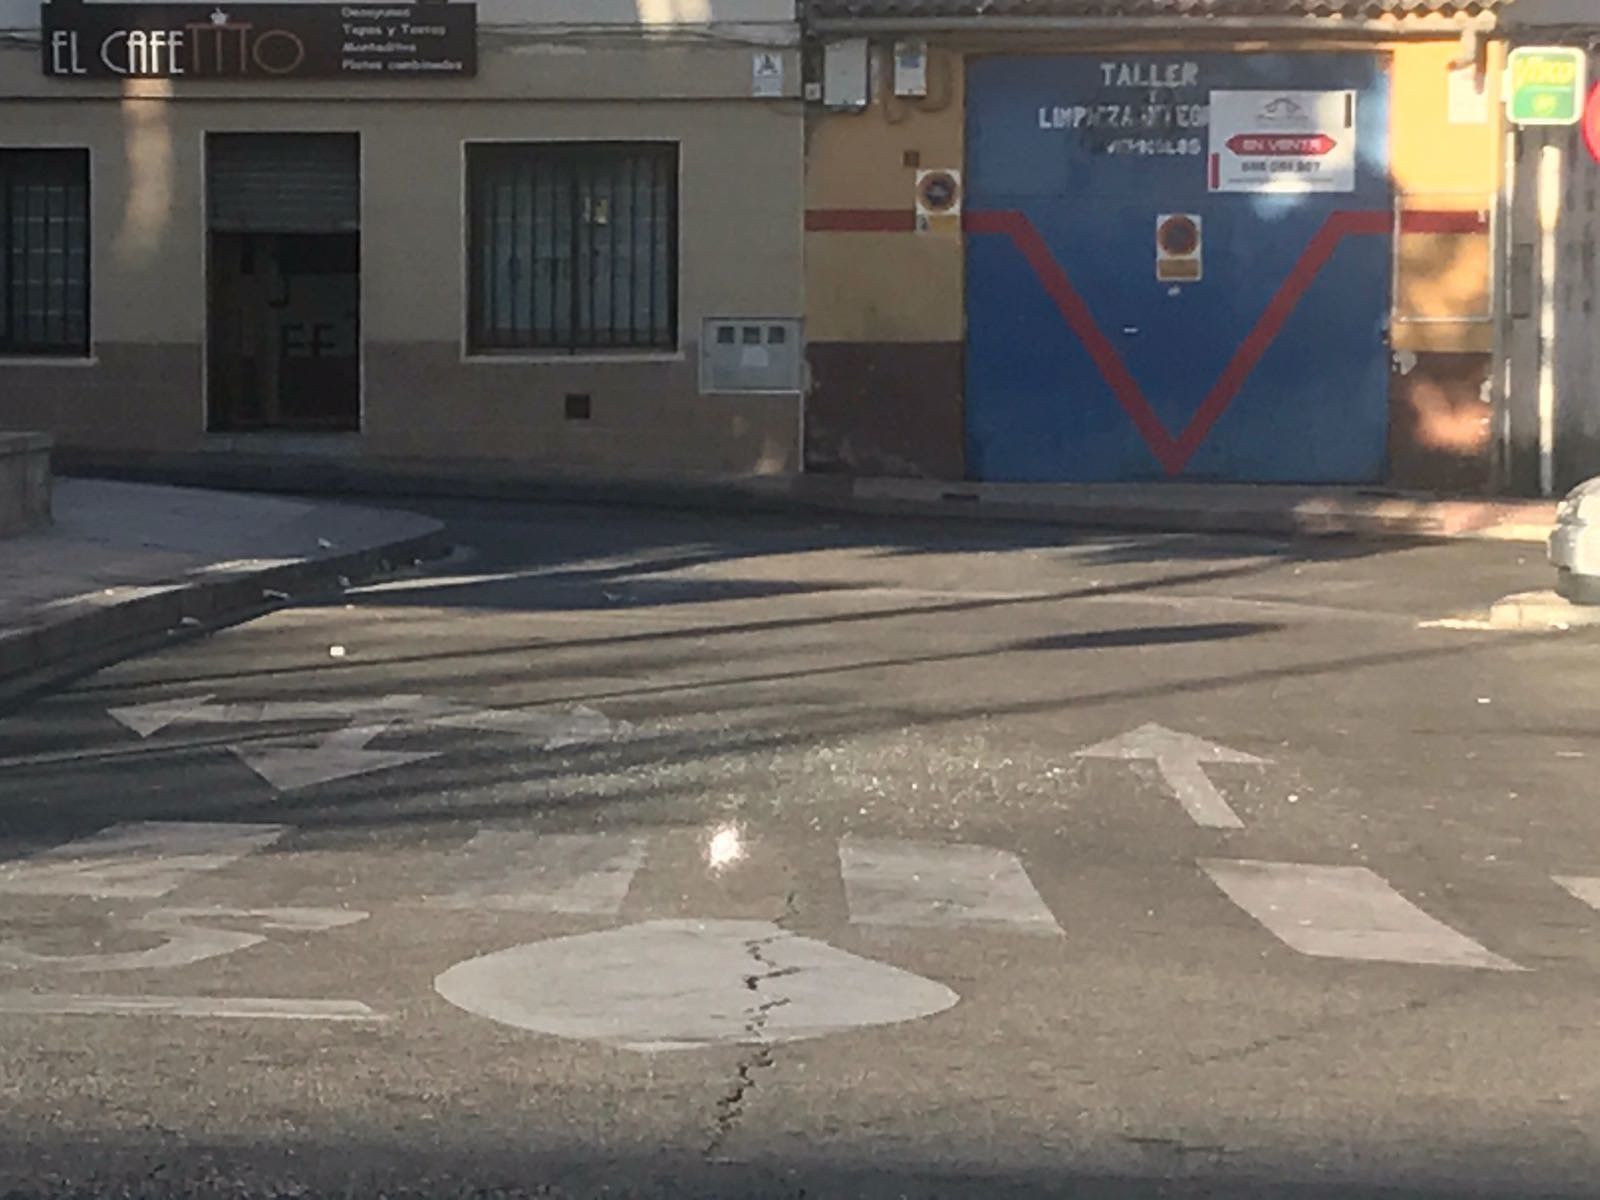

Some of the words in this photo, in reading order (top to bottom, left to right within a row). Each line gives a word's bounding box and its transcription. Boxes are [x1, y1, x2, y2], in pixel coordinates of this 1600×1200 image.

[341, 23, 383, 36] Tapas
[386, 26, 396, 37] y
[52, 30, 87, 74] EL
[1100, 62, 1199, 88] TALLER
